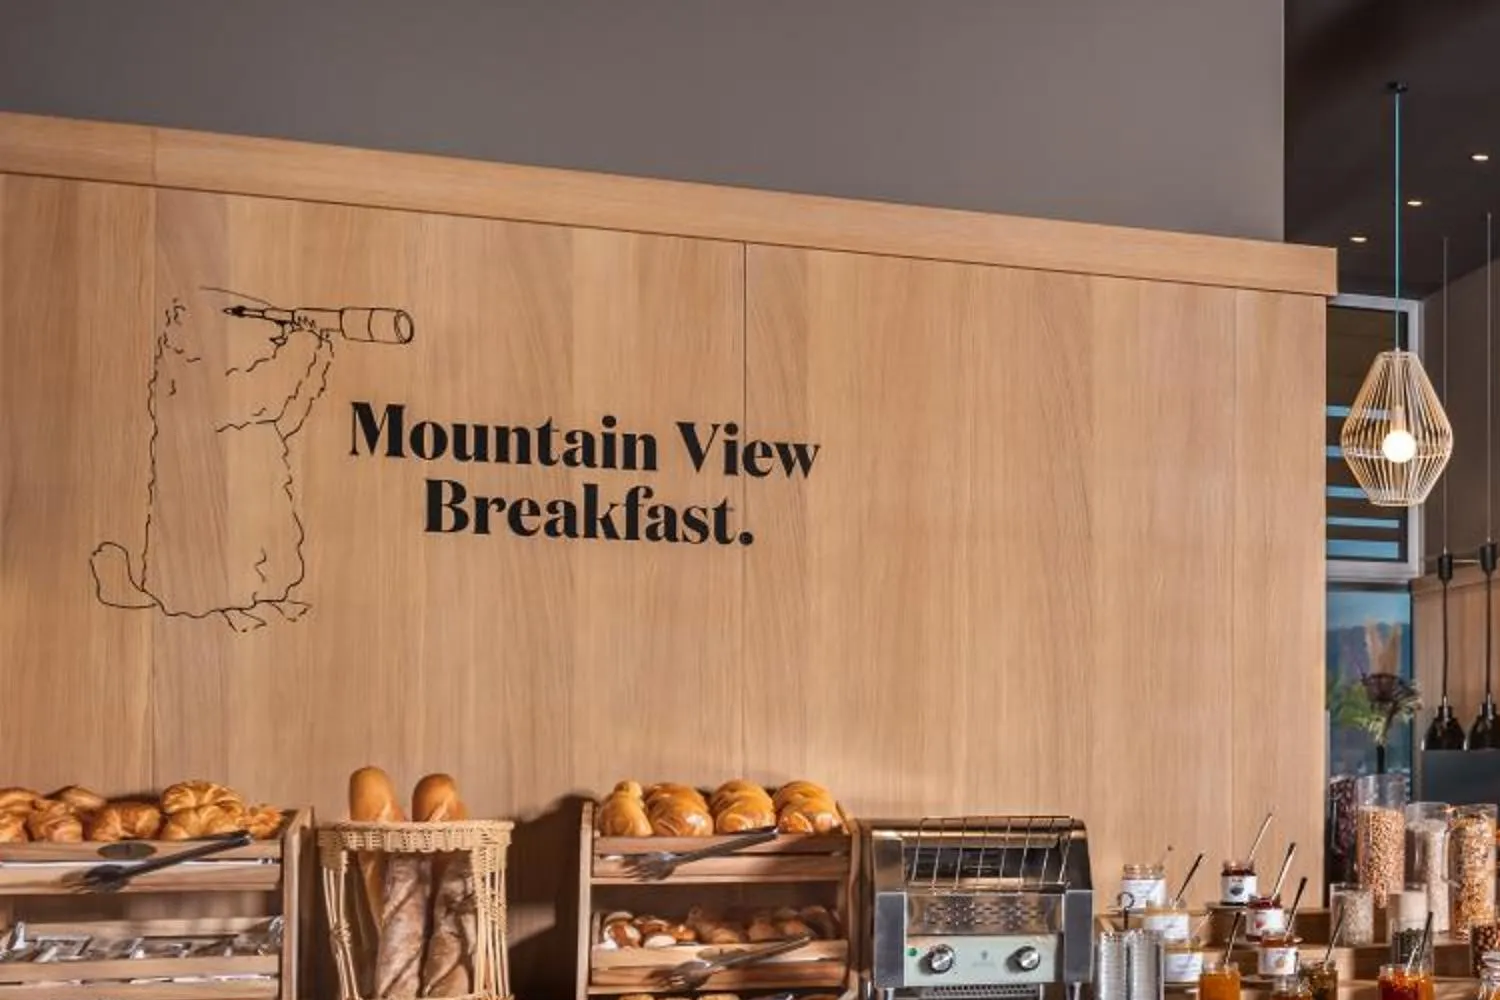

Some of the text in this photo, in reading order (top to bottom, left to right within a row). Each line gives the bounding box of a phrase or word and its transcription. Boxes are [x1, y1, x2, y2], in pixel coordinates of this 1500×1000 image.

[349, 401, 821, 479] Mountain View
[423, 477, 755, 546] Breakfast.
